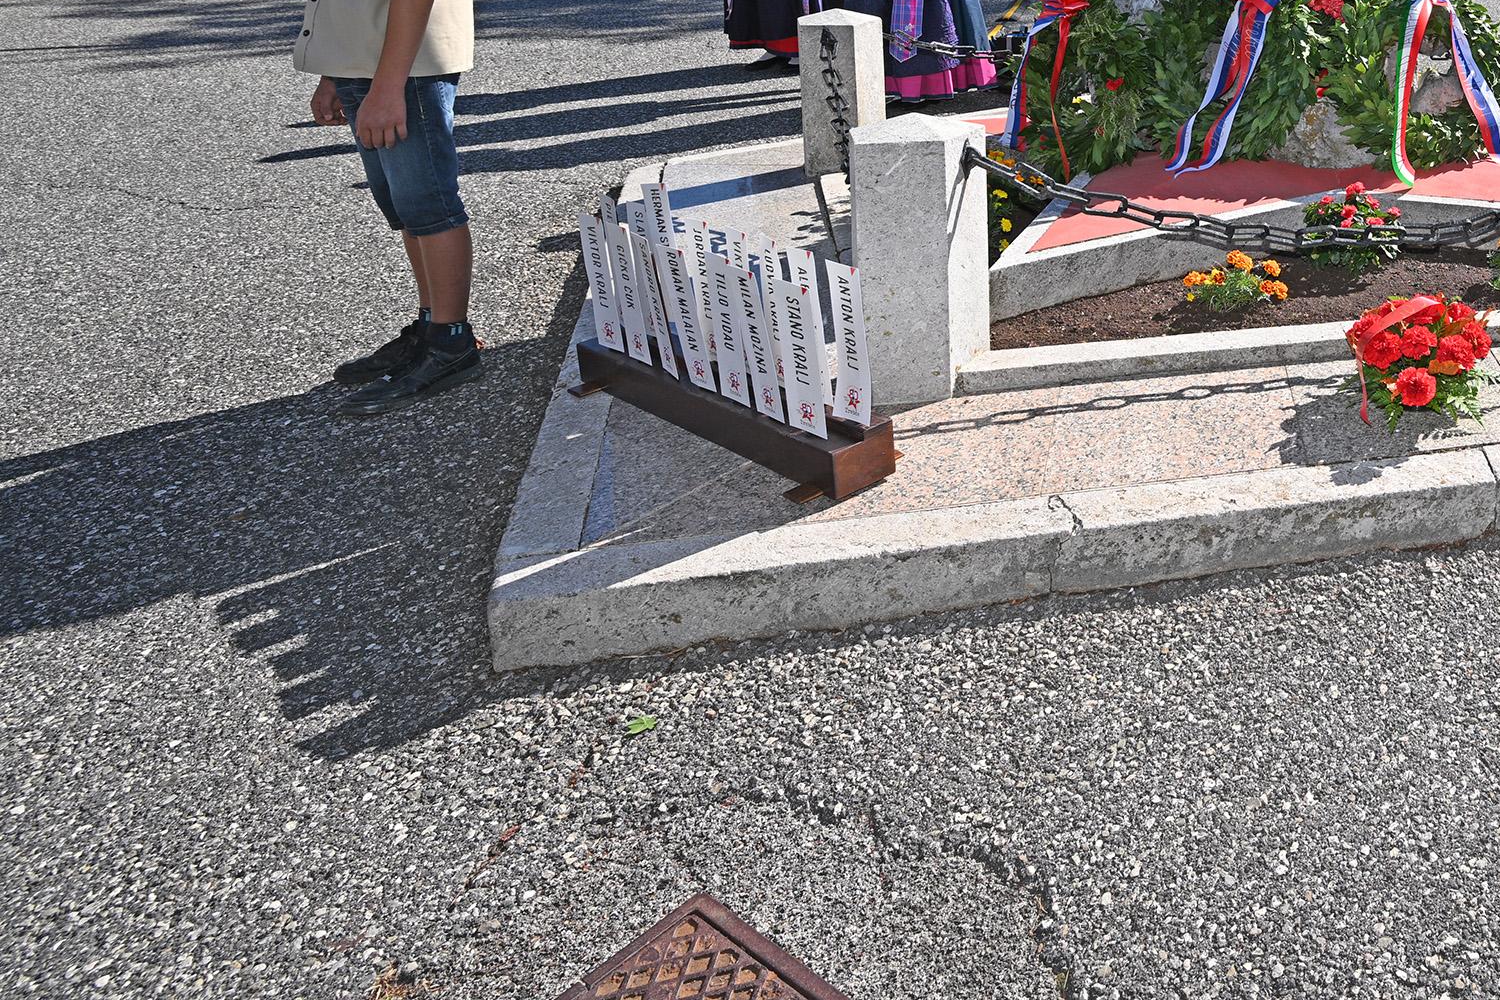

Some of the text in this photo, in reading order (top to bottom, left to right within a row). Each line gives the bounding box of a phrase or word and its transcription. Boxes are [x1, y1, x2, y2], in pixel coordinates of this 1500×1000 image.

[651, 189, 667, 233] HERMAN
[694, 228, 708, 276] JORDAN
[587, 226, 609, 308] VIKTOR KRALJ
[666, 252, 699, 352] ROMAN MALALAN
[715, 272, 729, 307] TILJO
[737, 276, 766, 374] MILAN MOŽINA
[786, 296, 810, 385] STANO KRALJ
[838, 276, 859, 371] ANTON KRALJ
